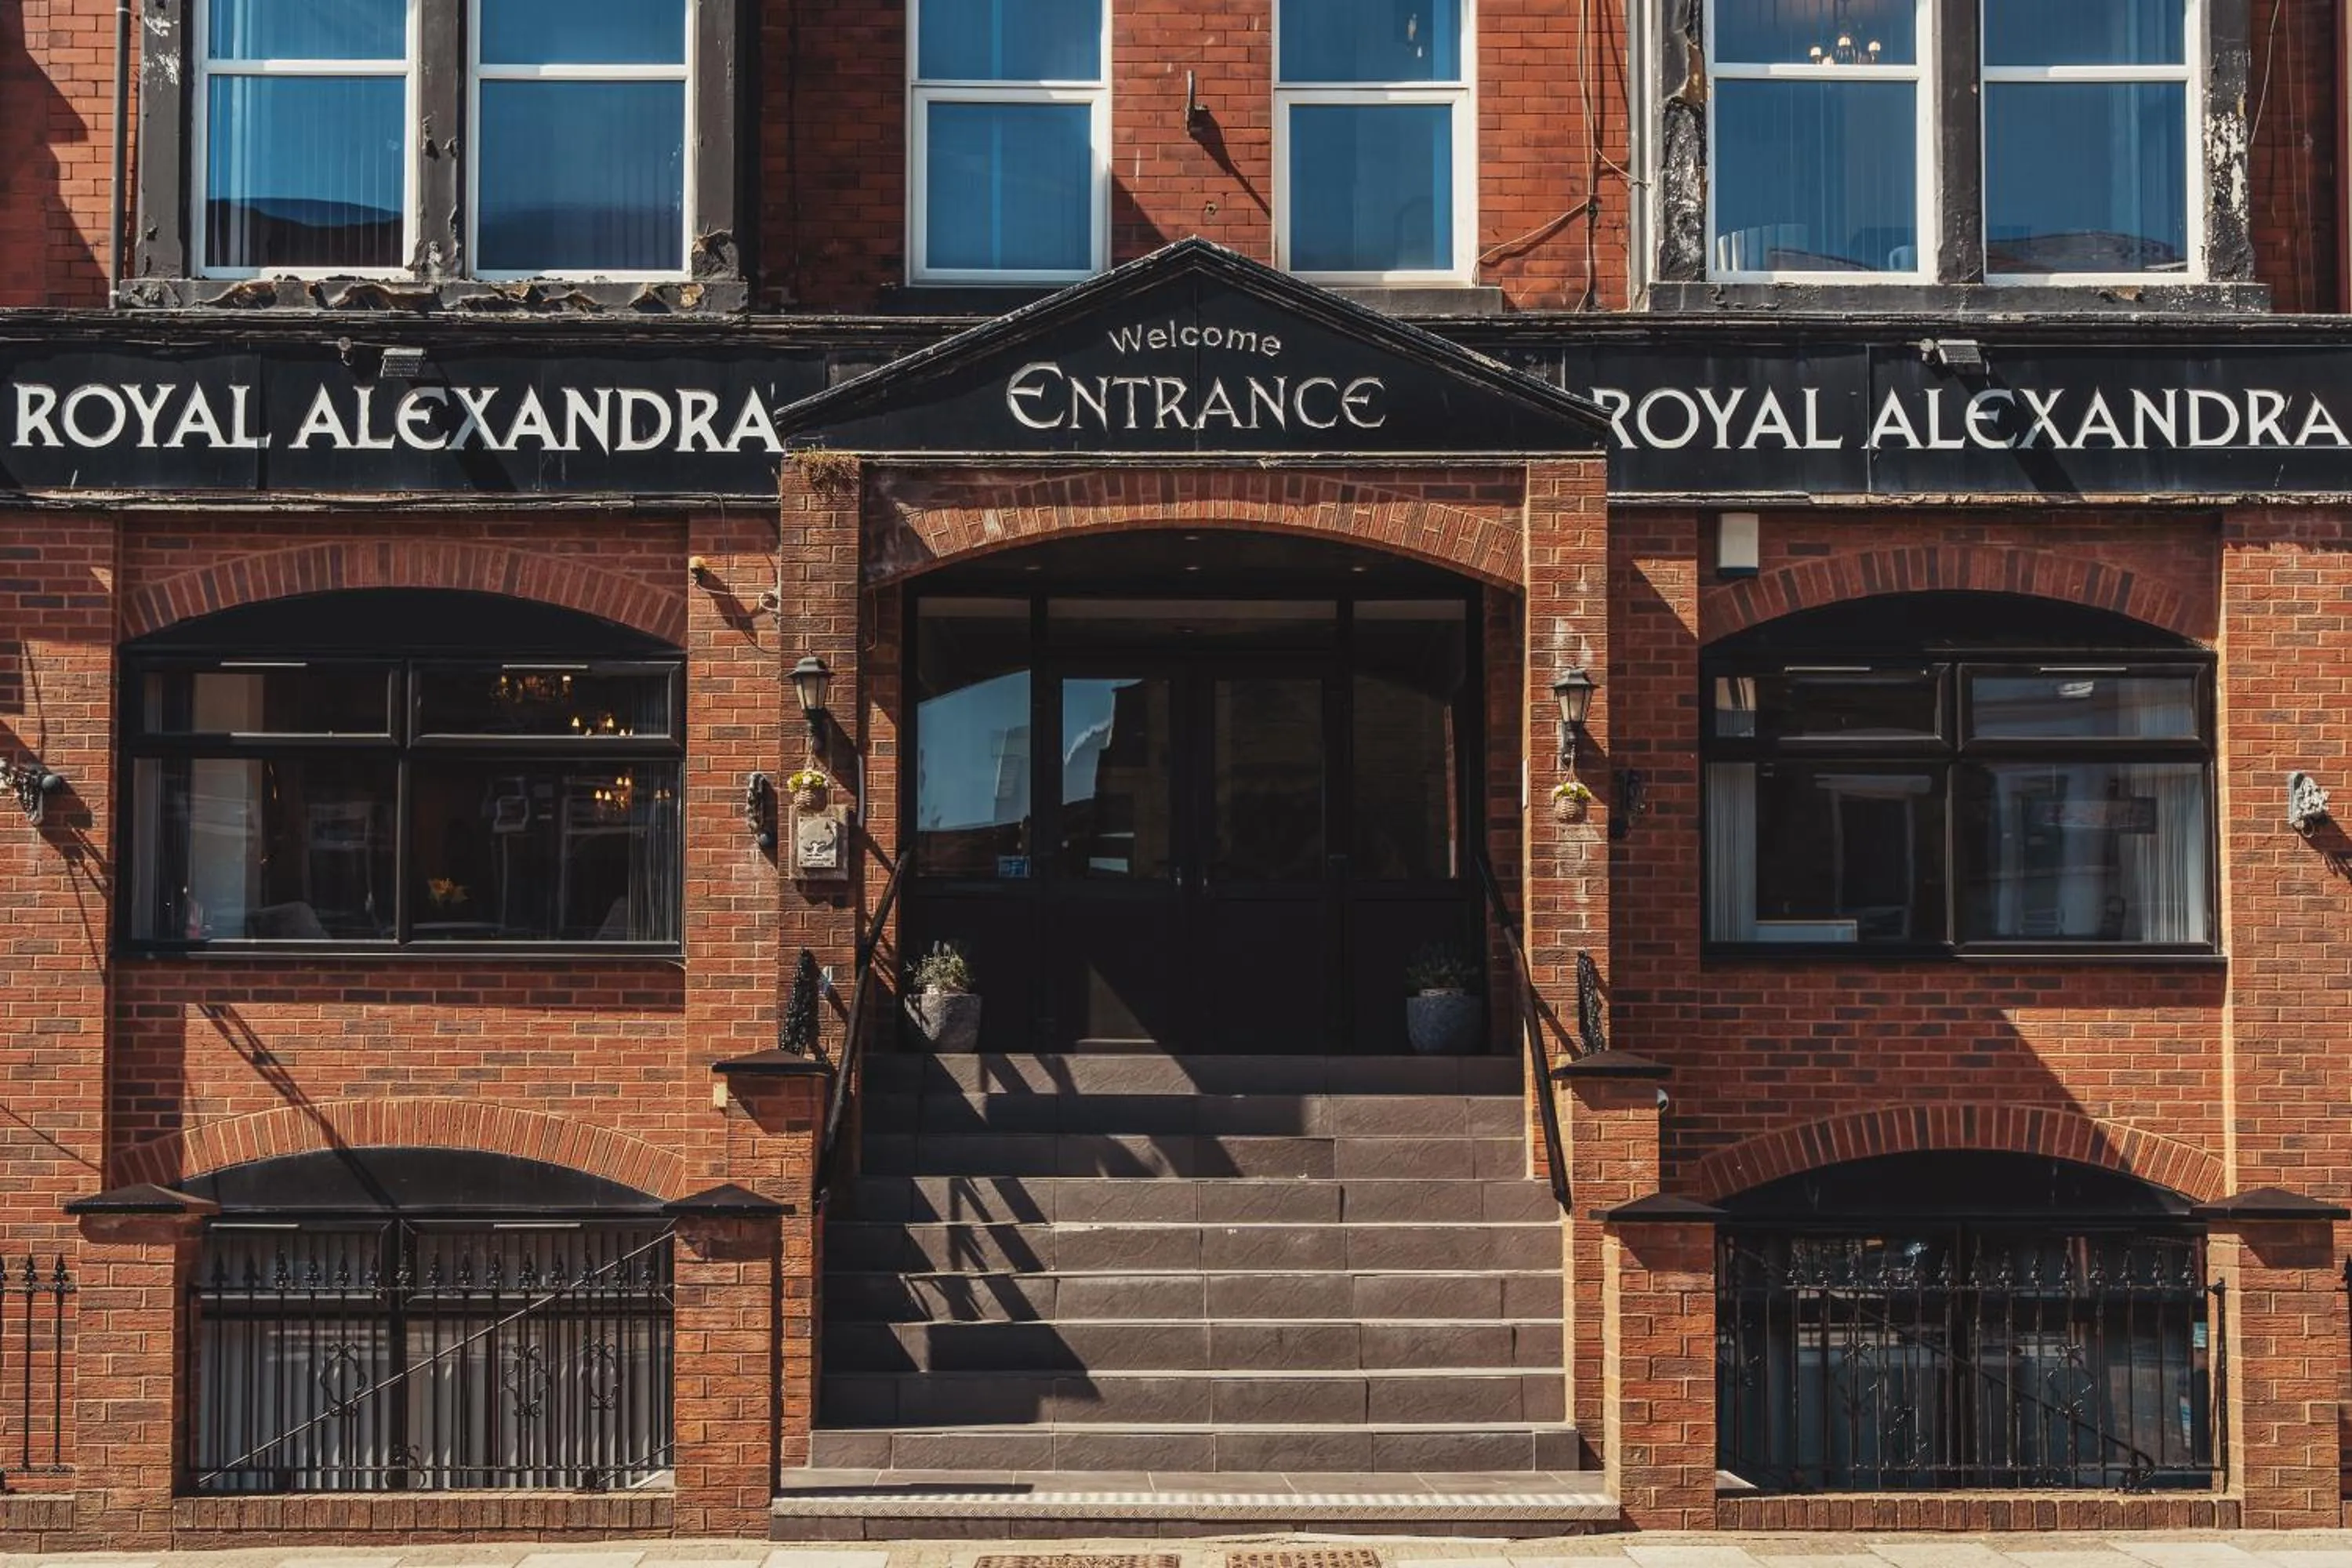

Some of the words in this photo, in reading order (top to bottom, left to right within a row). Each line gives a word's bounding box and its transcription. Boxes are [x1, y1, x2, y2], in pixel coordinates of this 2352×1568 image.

[1108, 319, 1282, 358] Welcome
[12, 381, 271, 449] ROYAL
[288, 383, 785, 452] ALEXANDRA
[1006, 361, 1386, 430] ENTRANCE
[1589, 386, 1843, 449] ROYAL
[1862, 387, 2352, 449] ALEXANDRA
